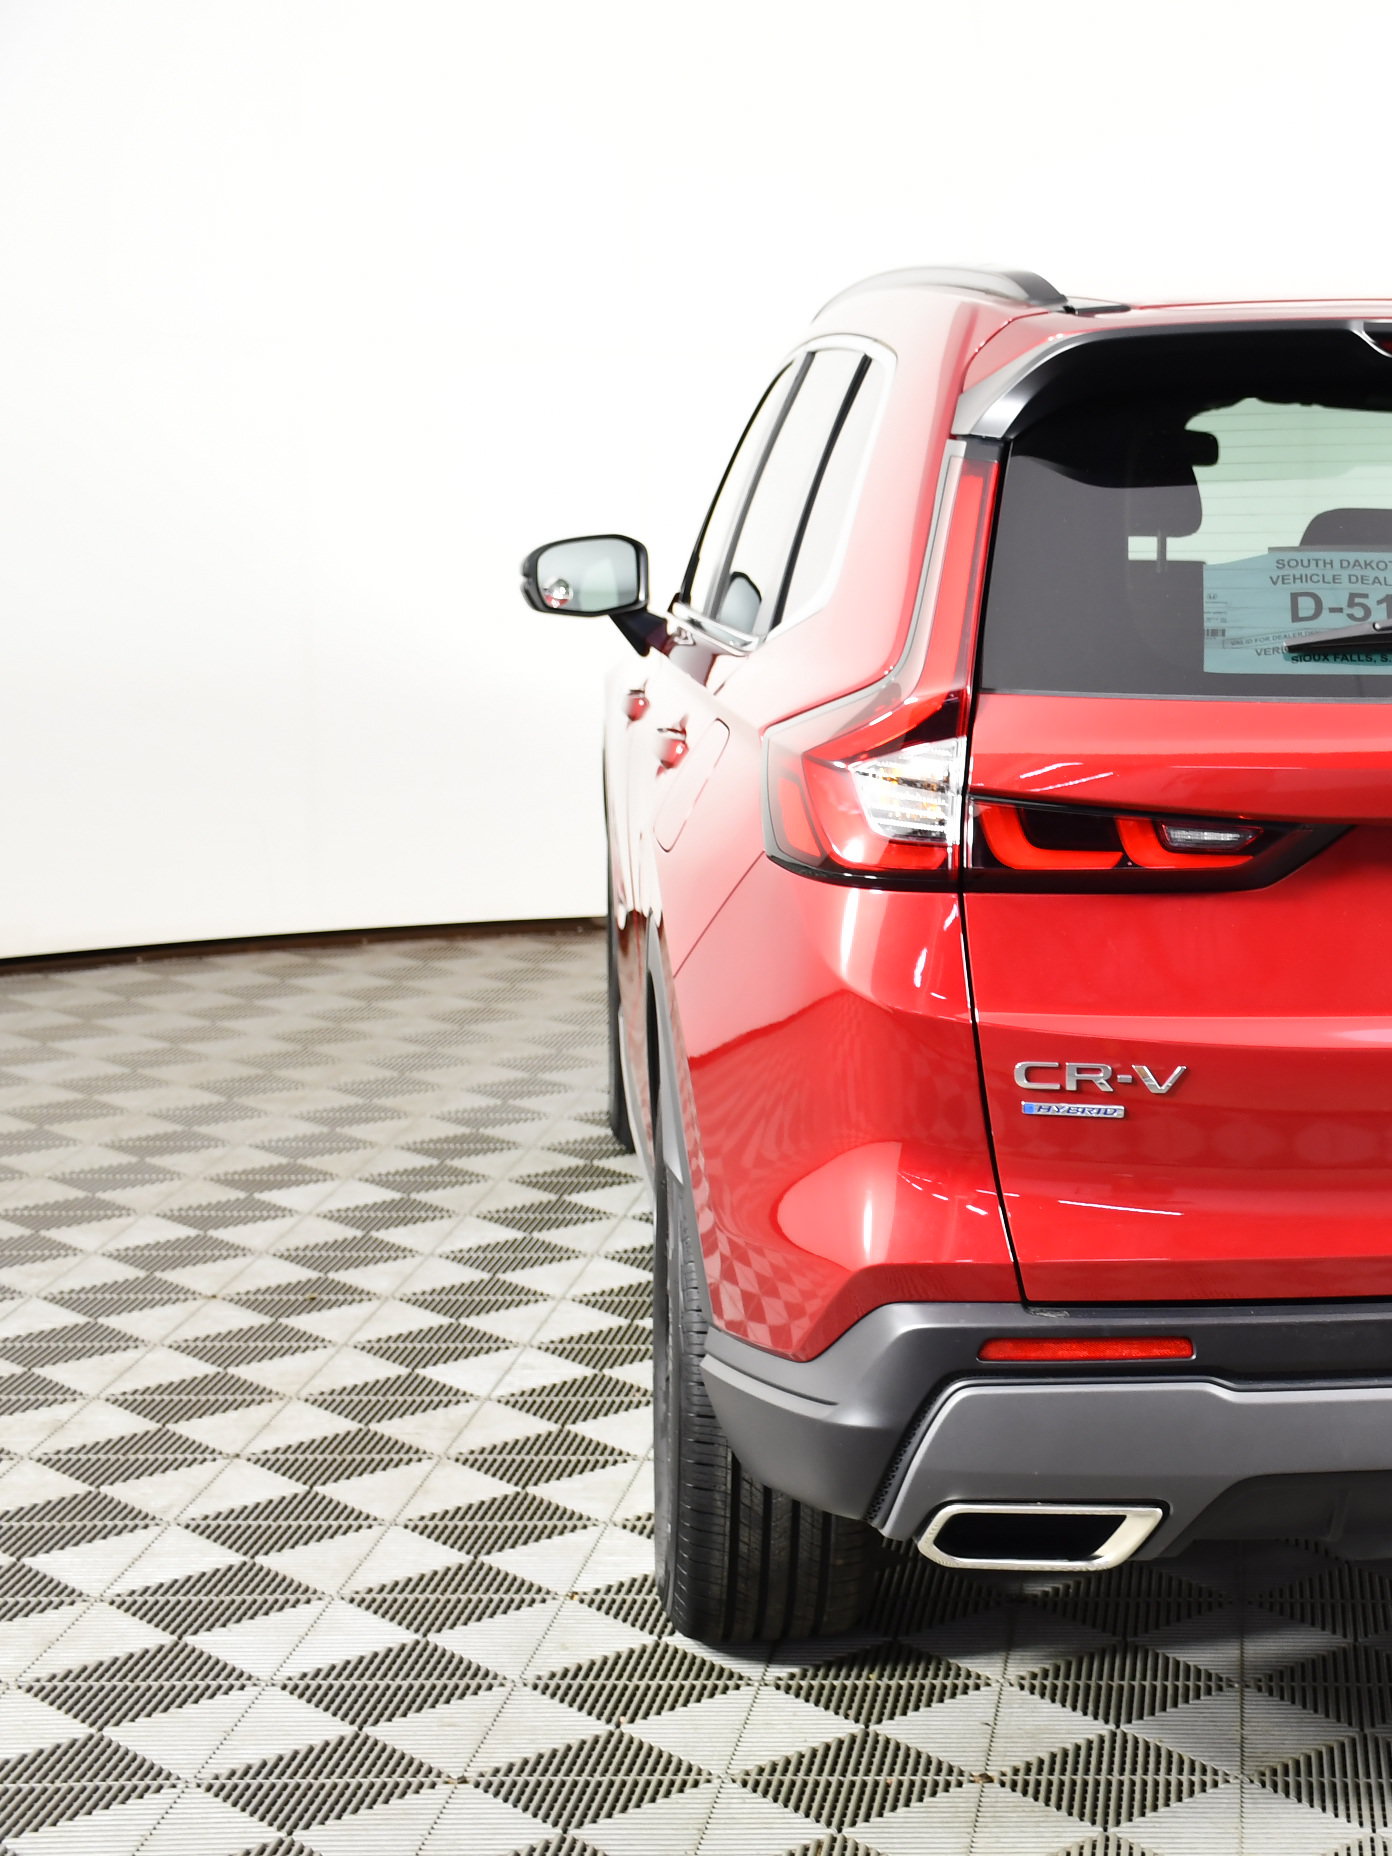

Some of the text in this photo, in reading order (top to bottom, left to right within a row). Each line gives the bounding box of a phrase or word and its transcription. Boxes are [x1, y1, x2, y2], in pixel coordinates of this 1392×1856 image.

[1275, 558, 1334, 570] SOUTH
[1269, 574, 1342, 586] VEHICLE
[1291, 653, 1331, 664] SIOUX
[1333, 653, 1378, 664] FALLS,
[1013, 1061, 1187, 1094] CR-V
[1036, 1104, 1119, 1116] HYBRID
